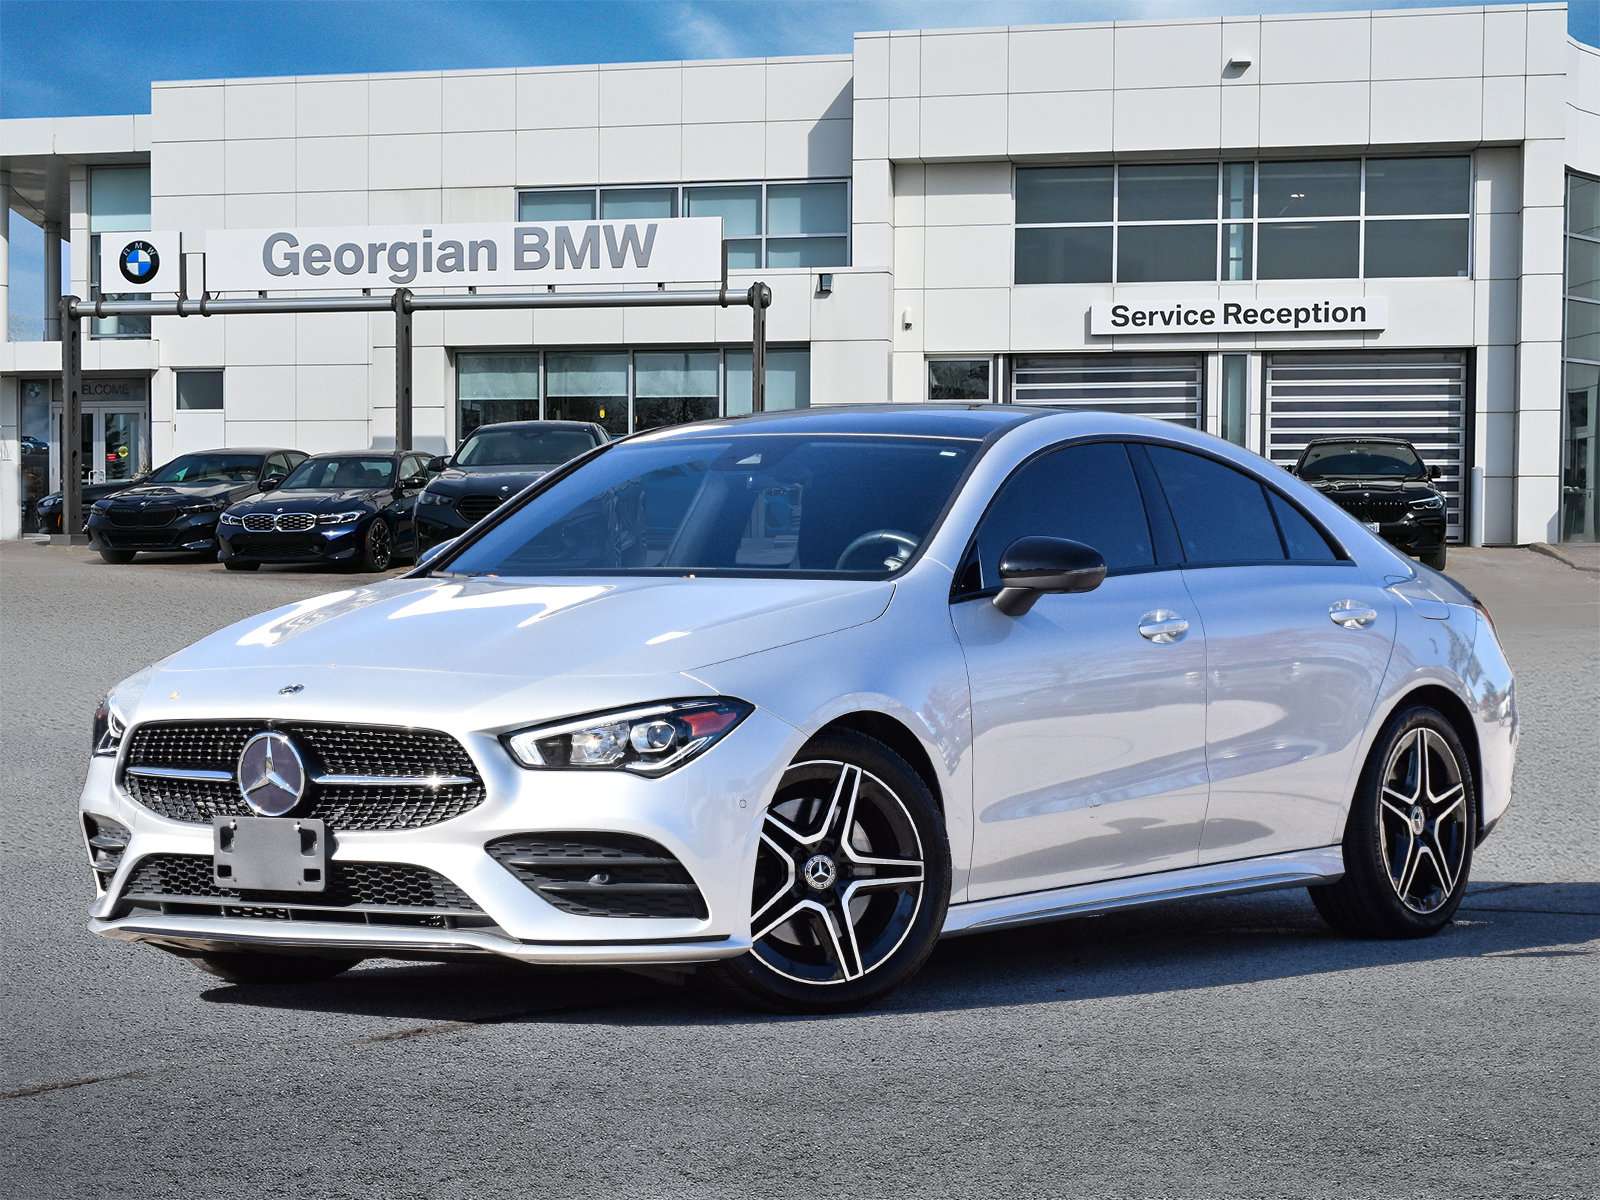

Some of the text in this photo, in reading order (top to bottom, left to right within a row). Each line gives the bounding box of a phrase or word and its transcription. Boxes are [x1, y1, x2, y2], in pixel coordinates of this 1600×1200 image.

[122, 242, 157, 256] BMW
[262, 223, 658, 284] Georgian BMW
[1111, 301, 1367, 328] Service Reception
[80, 383, 129, 395] ELCOME
